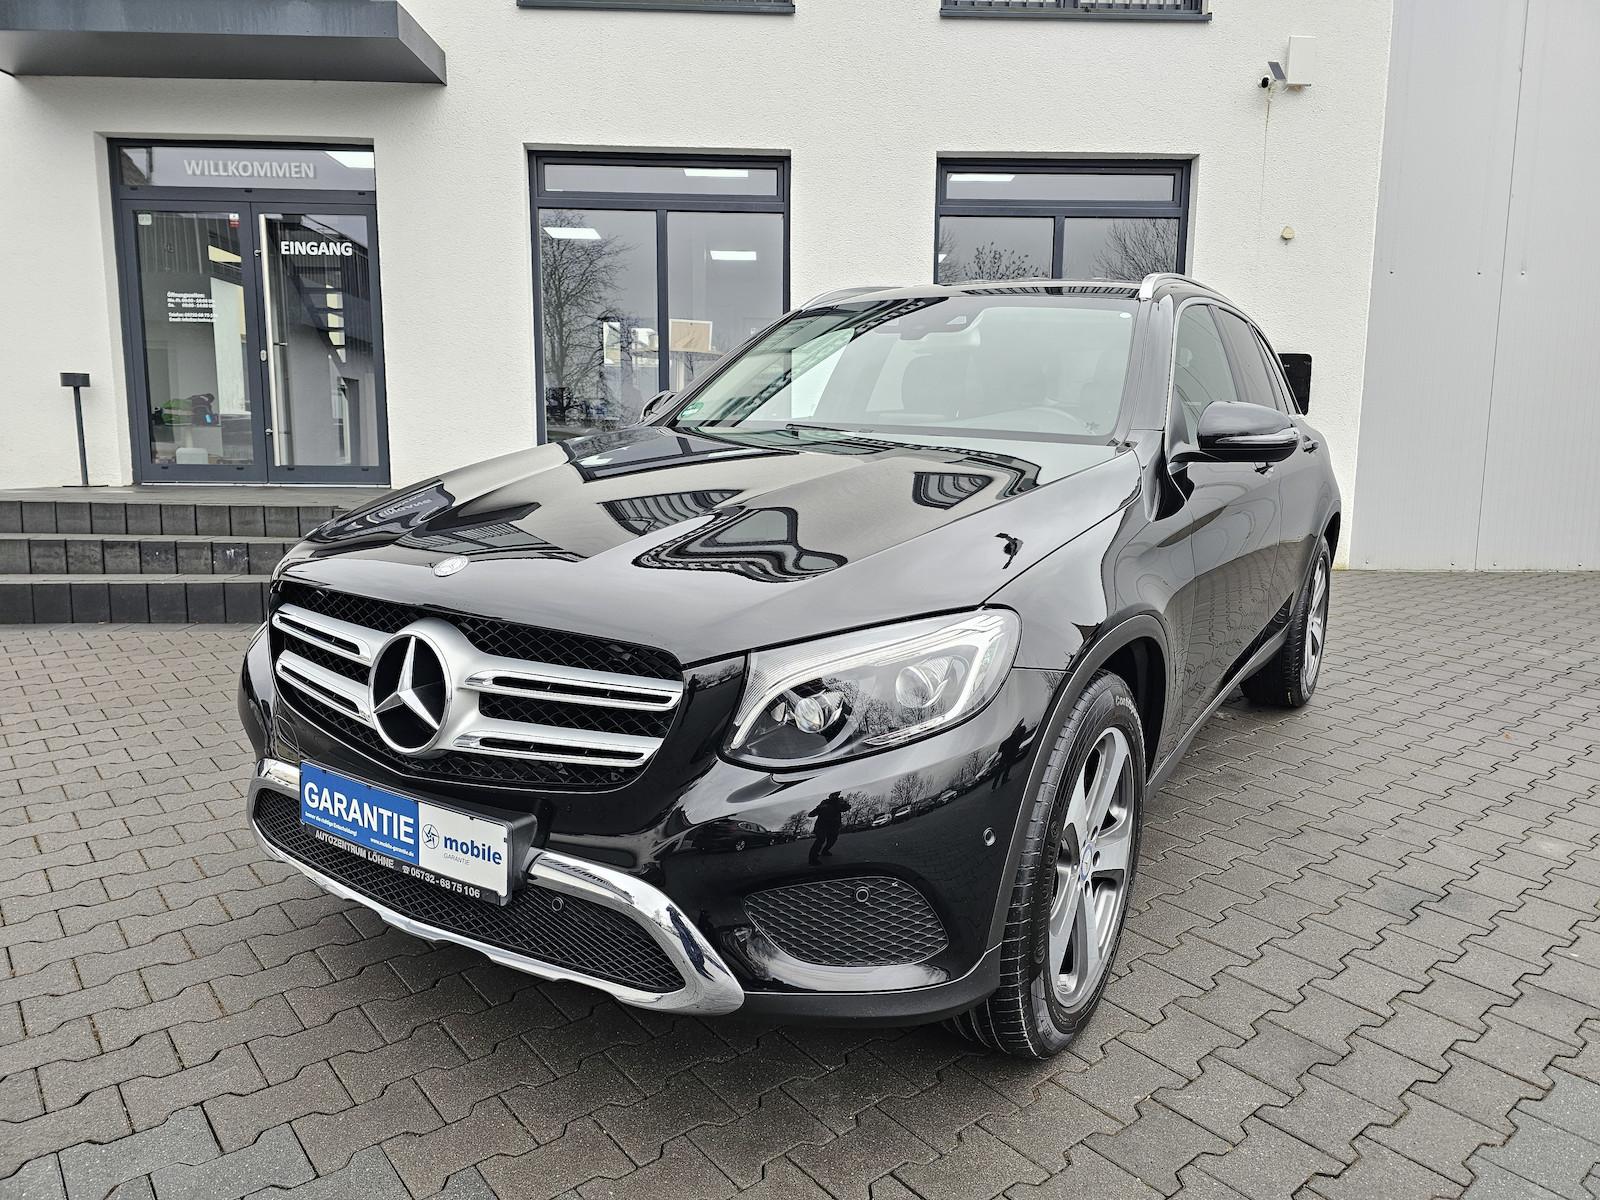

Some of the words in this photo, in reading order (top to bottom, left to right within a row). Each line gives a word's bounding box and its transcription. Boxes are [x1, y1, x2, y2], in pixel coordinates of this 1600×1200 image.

[184, 159, 315, 178] WILLKOMMEN
[280, 240, 353, 257] EINGANG
[304, 782, 415, 845] GARANTIE
[315, 830, 367, 858] AUTOZENTRUM
[368, 850, 394, 869] LÖHNE
[443, 835, 502, 865] mobile
[443, 852, 470, 866] GARANTIE
[464, 885, 480, 898] 106
